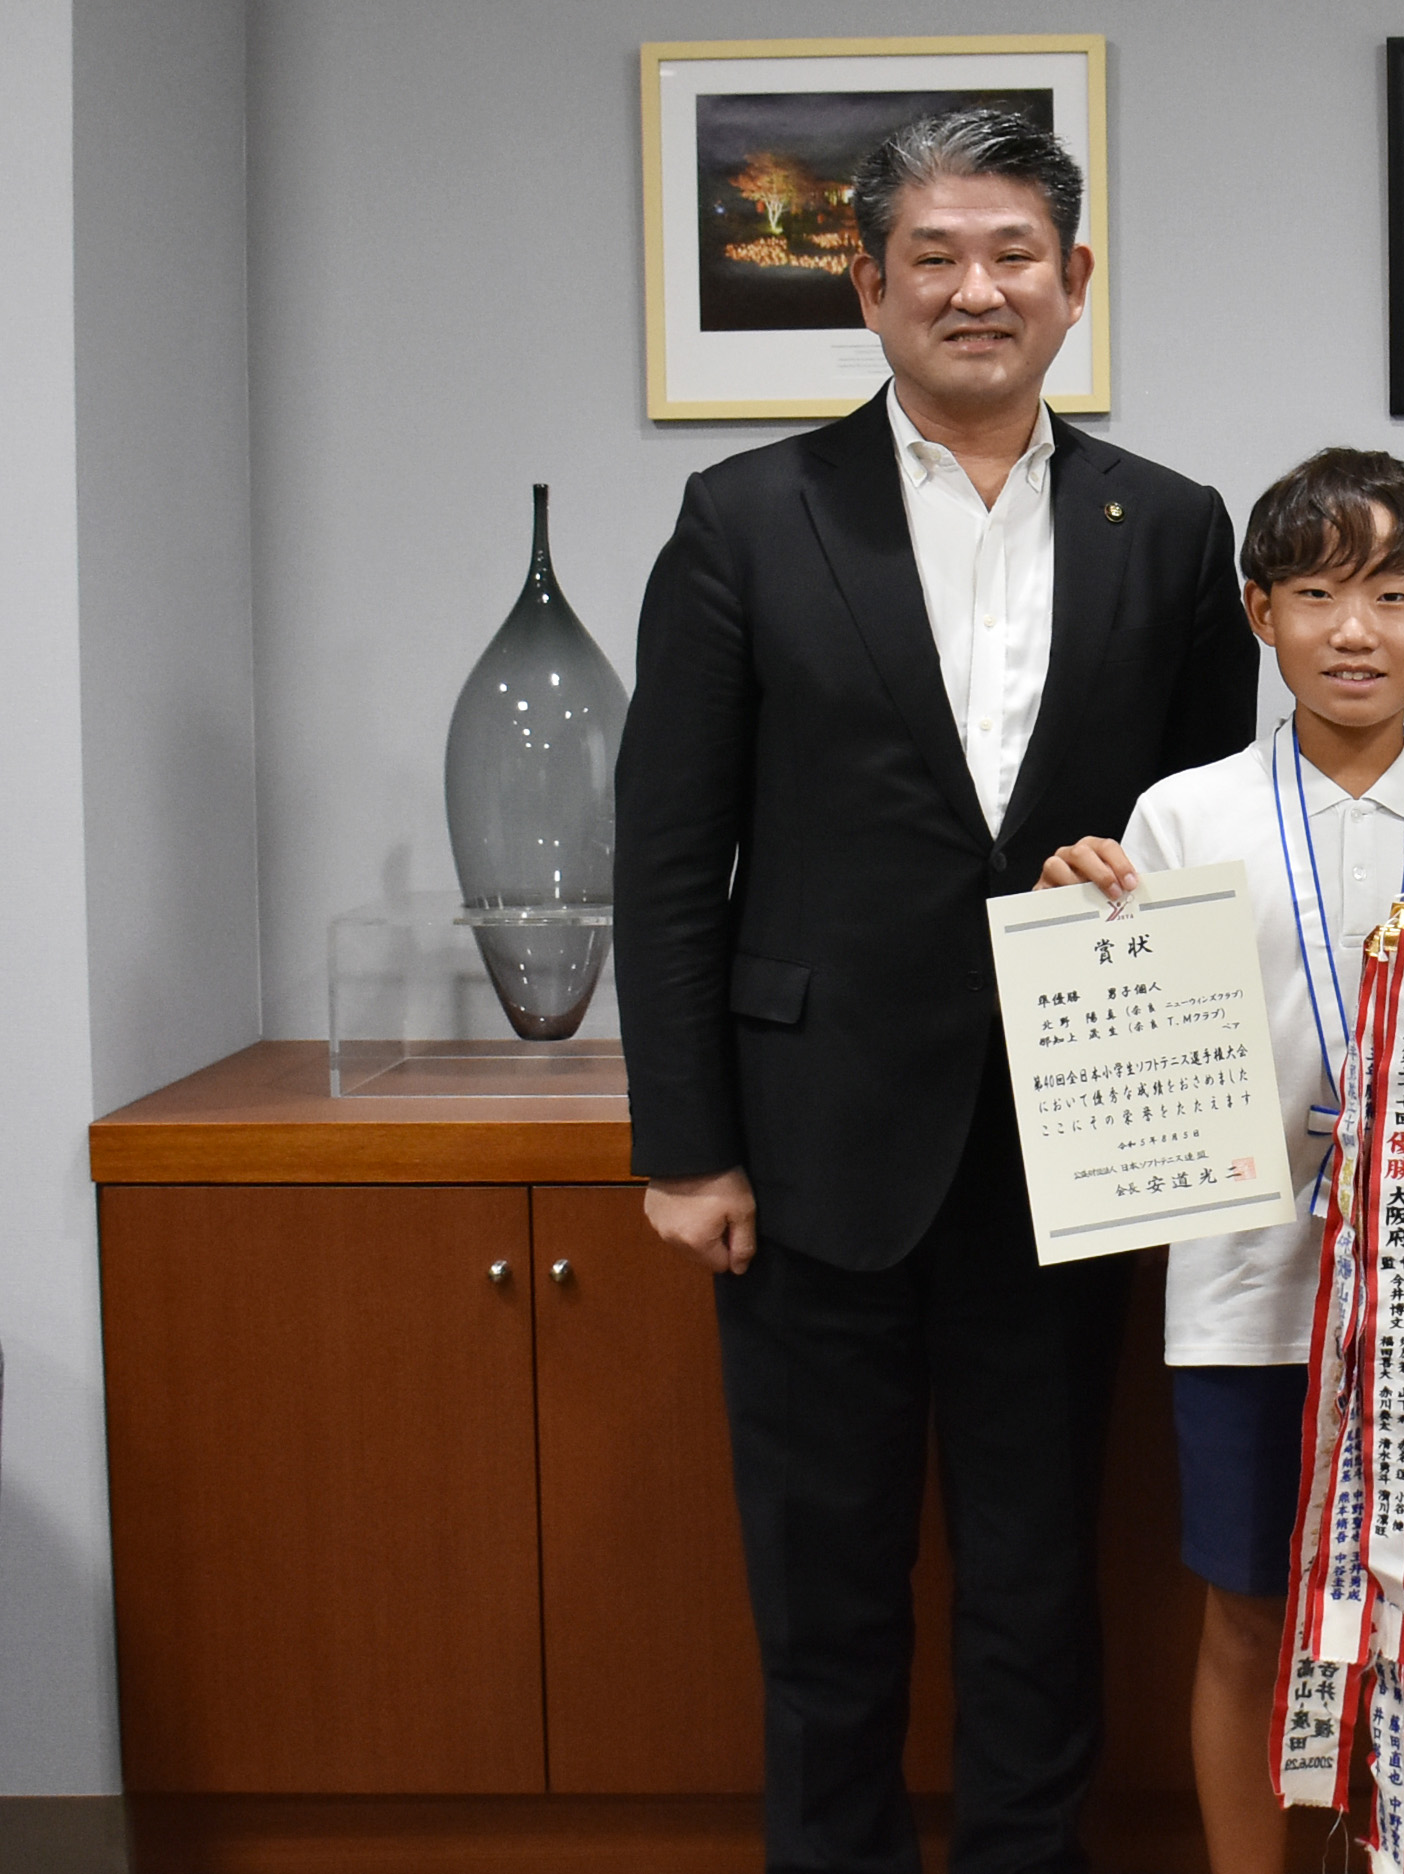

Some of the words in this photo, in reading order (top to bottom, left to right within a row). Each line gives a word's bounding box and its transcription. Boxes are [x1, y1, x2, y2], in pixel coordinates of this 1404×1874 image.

[1093, 933, 1154, 965] 賞状
[1038, 990, 1081, 1008] 準優勝
[1106, 981, 1163, 1001] 男子個人
[1033, 1043, 1249, 1092] 第40回全日本小学生ソフトテニス選手権大会
[1038, 1067, 1249, 1114] において優秀な成績をおさめました
[1041, 1090, 1252, 1138] ここにその栄誉をたたえます
[1114, 1182, 1142, 1198] 会長
[1145, 1163, 1243, 1195] 安道光二
